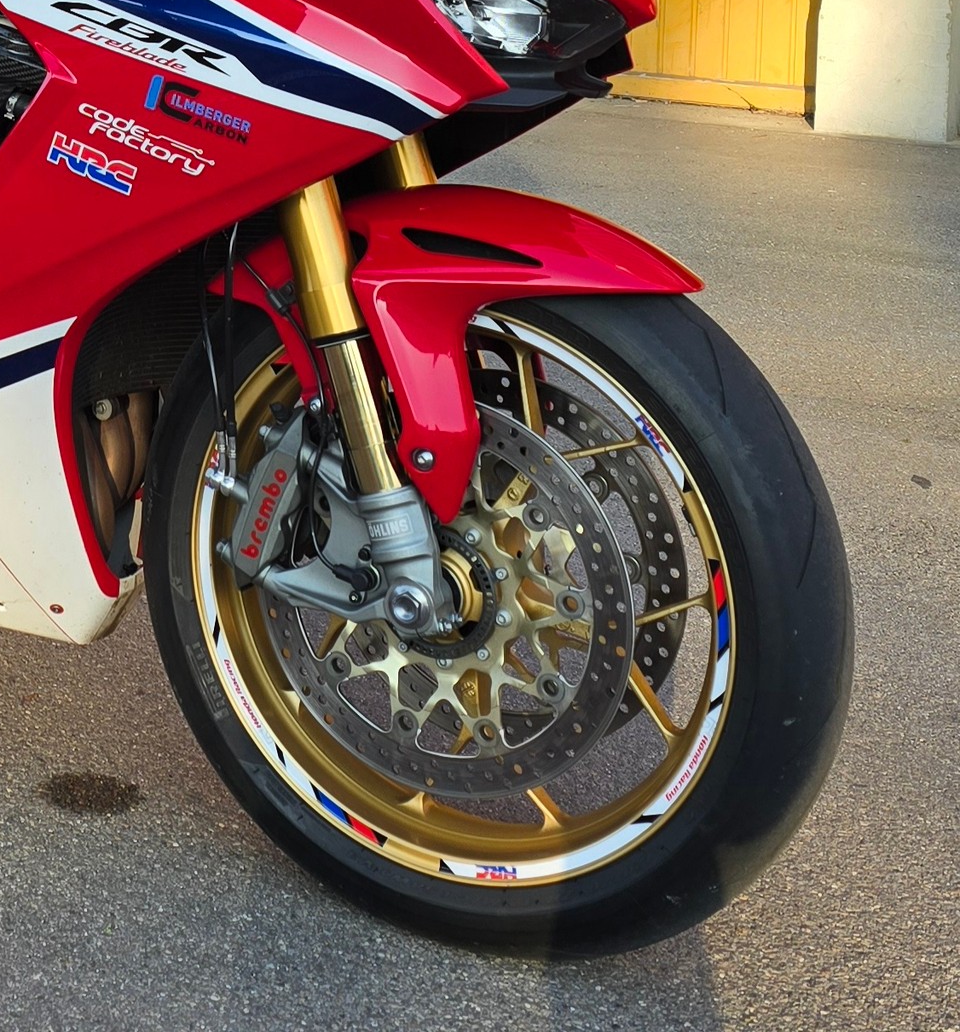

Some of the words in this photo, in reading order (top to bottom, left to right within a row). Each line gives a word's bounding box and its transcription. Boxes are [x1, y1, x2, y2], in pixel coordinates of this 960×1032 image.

[50, 1, 231, 77] CBR
[68, 23, 187, 71] Fireblade
[170, 93, 252, 134] ILMBERGER
[47, 131, 138, 196] HRC
[635, 414, 671, 457] HRC
[240, 469, 288, 559] brembo
[223, 658, 242, 695] Racing
[240, 696, 261, 729] Honda
[688, 735, 709, 770] Honda
[665, 769, 692, 802] Racing
